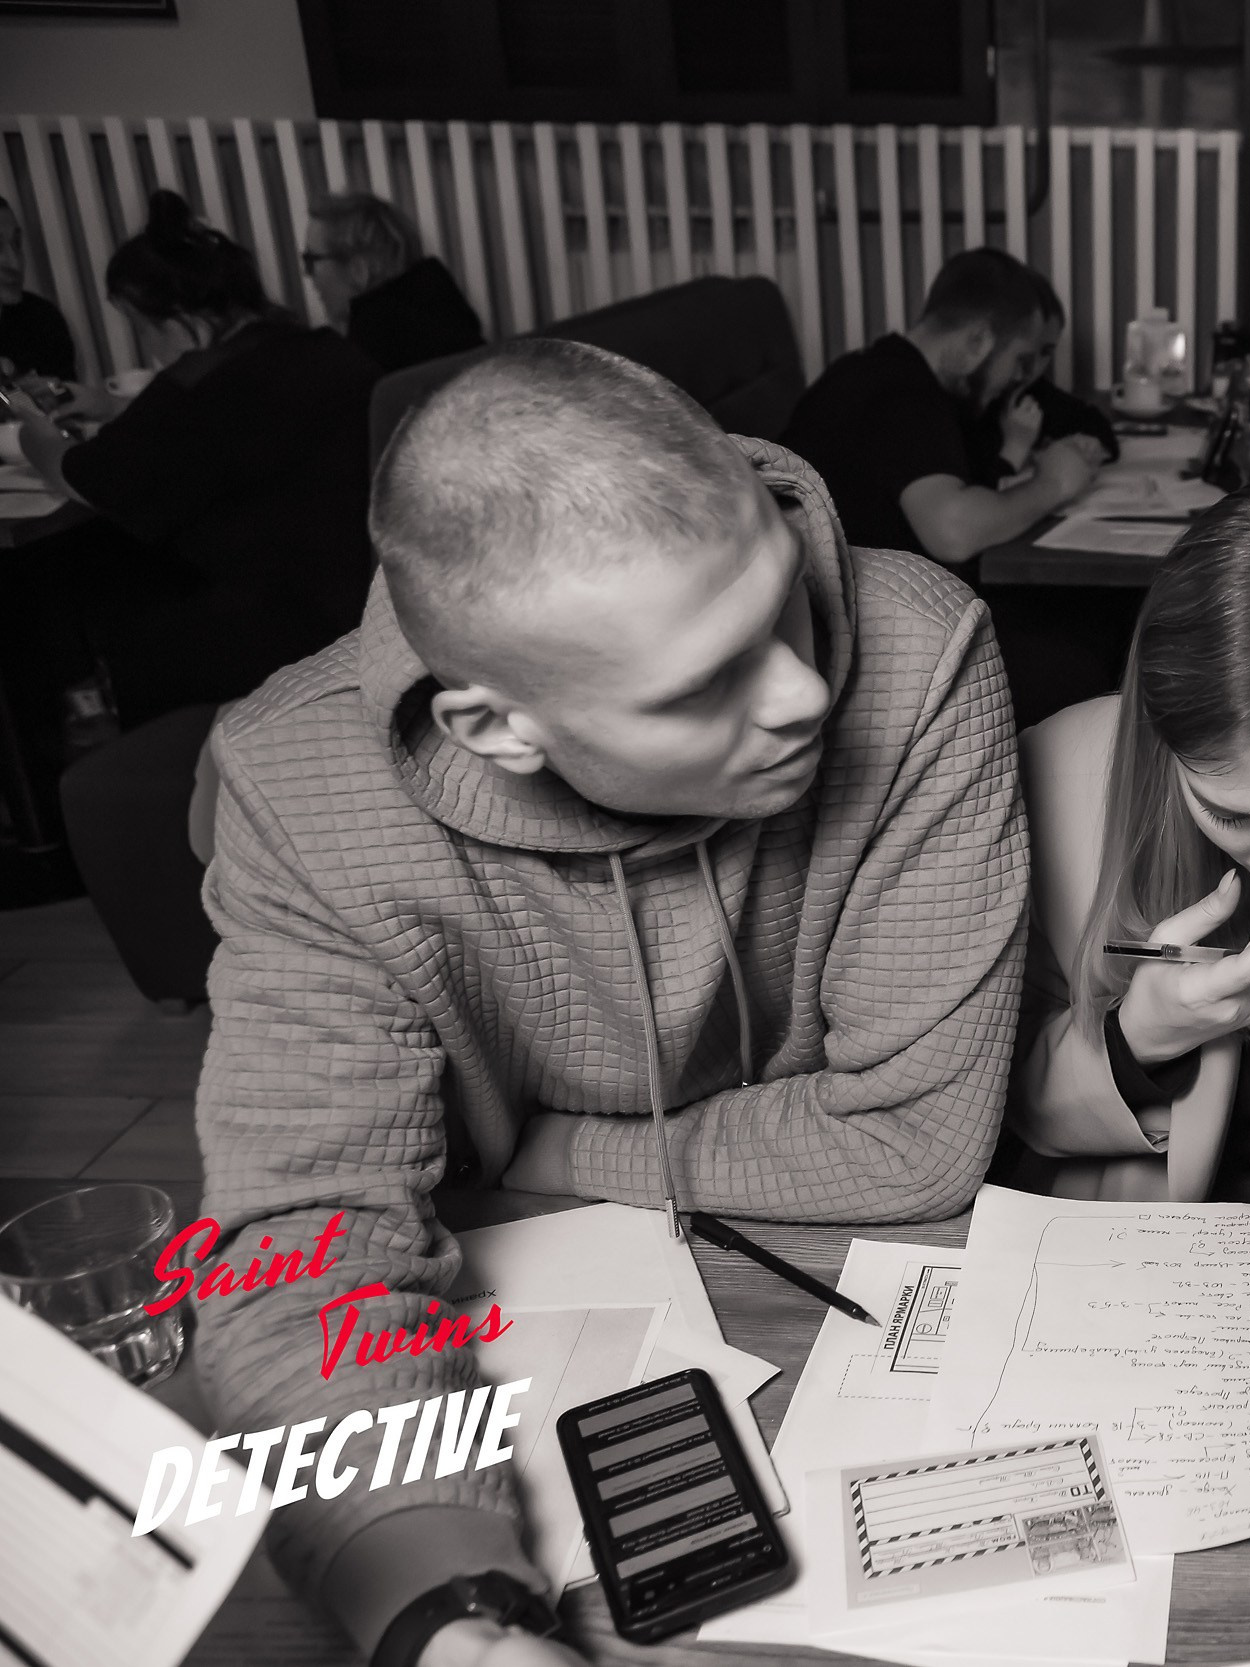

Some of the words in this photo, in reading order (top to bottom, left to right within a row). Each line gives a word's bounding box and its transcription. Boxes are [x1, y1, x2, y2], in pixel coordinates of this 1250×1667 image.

[884, 1325, 900, 1350] ПЛАН
[893, 1285, 915, 1324] ЯРМАРКИ
[1070, 1484, 1092, 1497] TO
